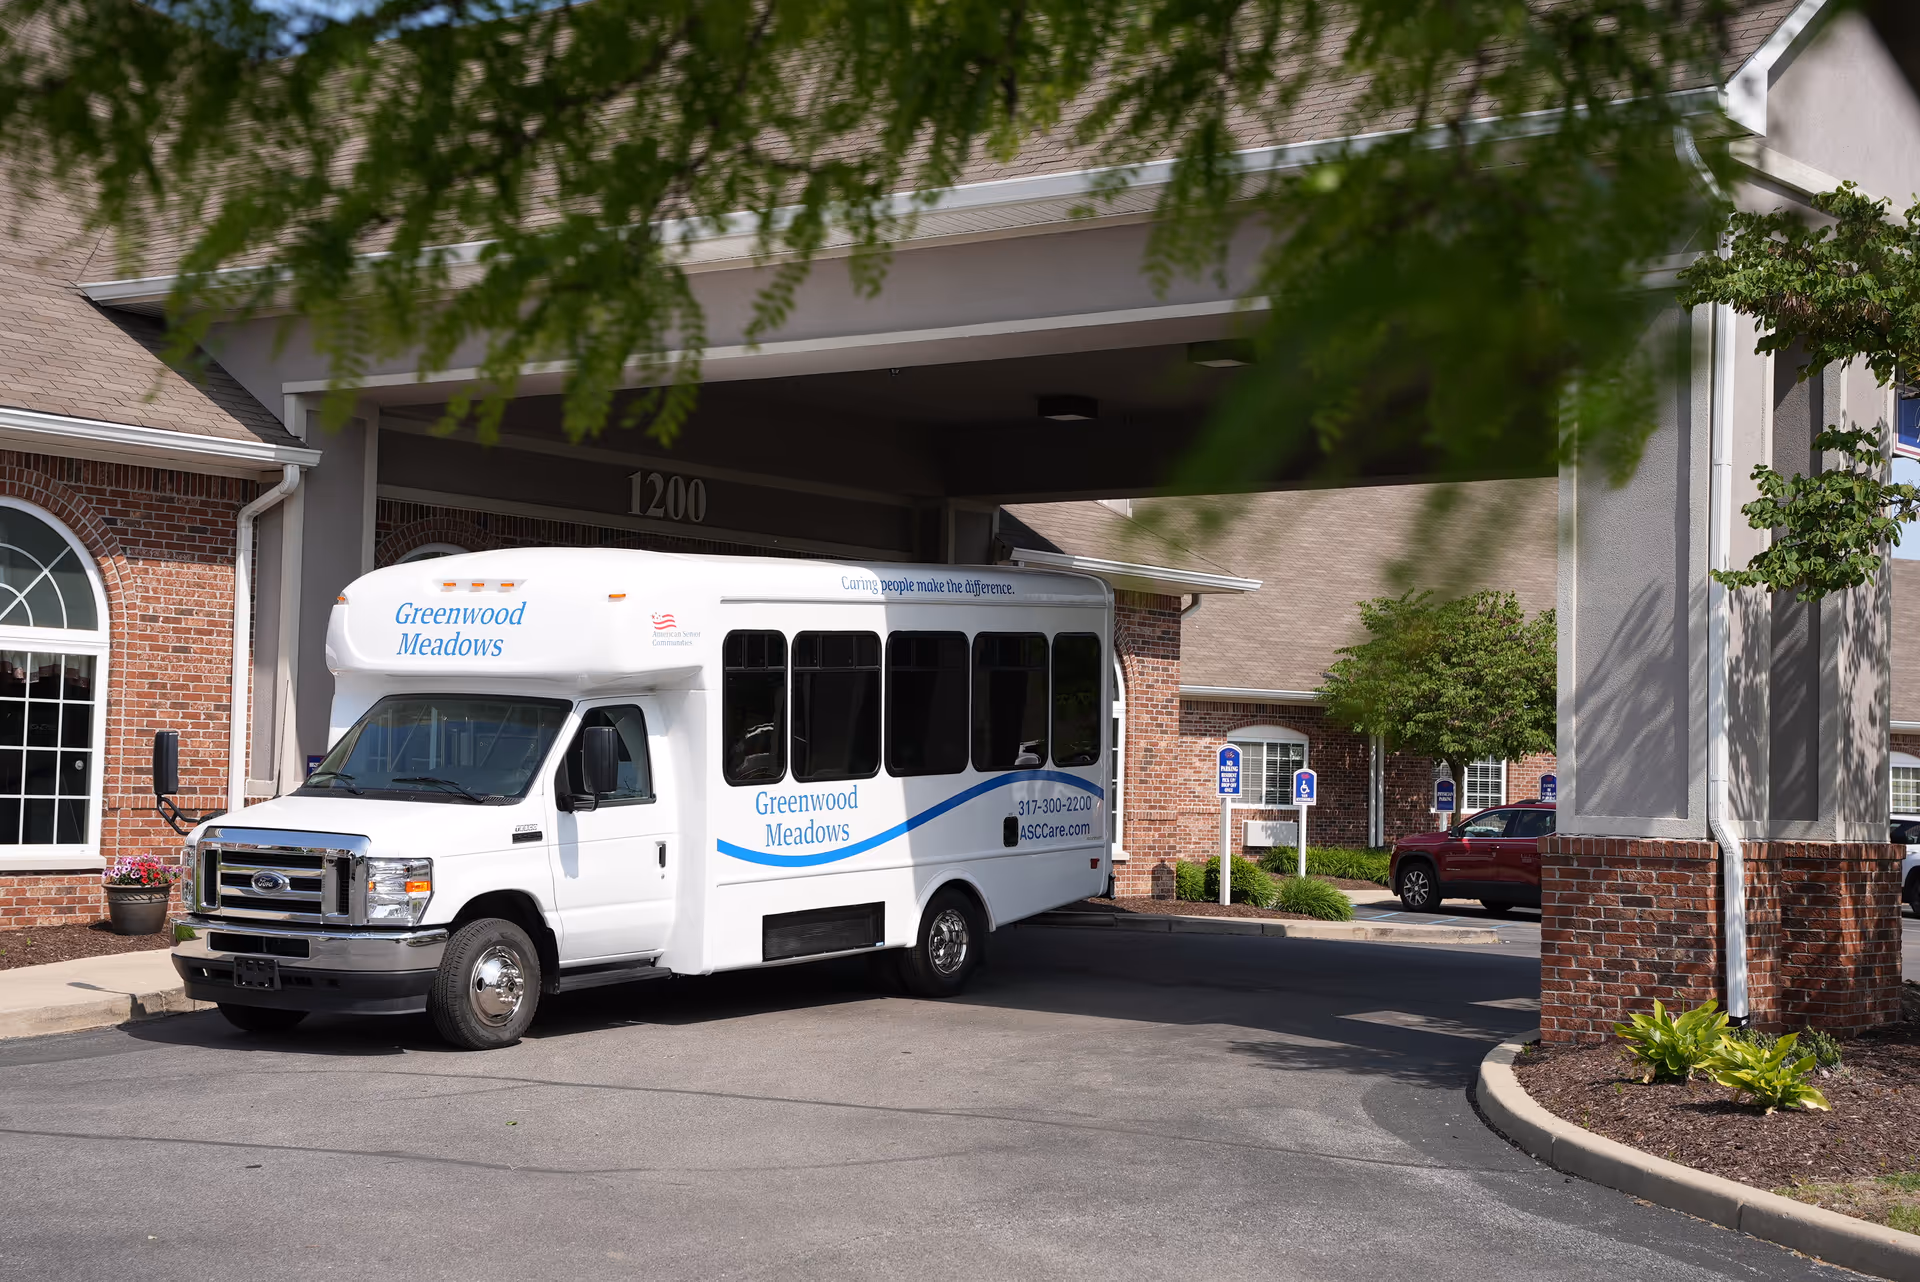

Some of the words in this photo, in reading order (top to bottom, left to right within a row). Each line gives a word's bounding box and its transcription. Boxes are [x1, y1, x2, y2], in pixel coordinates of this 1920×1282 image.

[625, 470, 707, 523] 1200
[841, 575, 878, 595] Caring
[879, 576, 915, 596] people
[916, 577, 945, 593] make
[947, 578, 963, 594] the
[964, 578, 1015, 598] difference.
[395, 601, 527, 625] Greenwood
[396, 631, 504, 657] Meadows
[755, 784, 859, 815] Greenwood
[1018, 795, 1092, 816] 317-300-2200
[765, 818, 850, 847] Meadows
[1019, 823, 1090, 841] ASCCare.com
[257, 876, 273, 887] Ford
